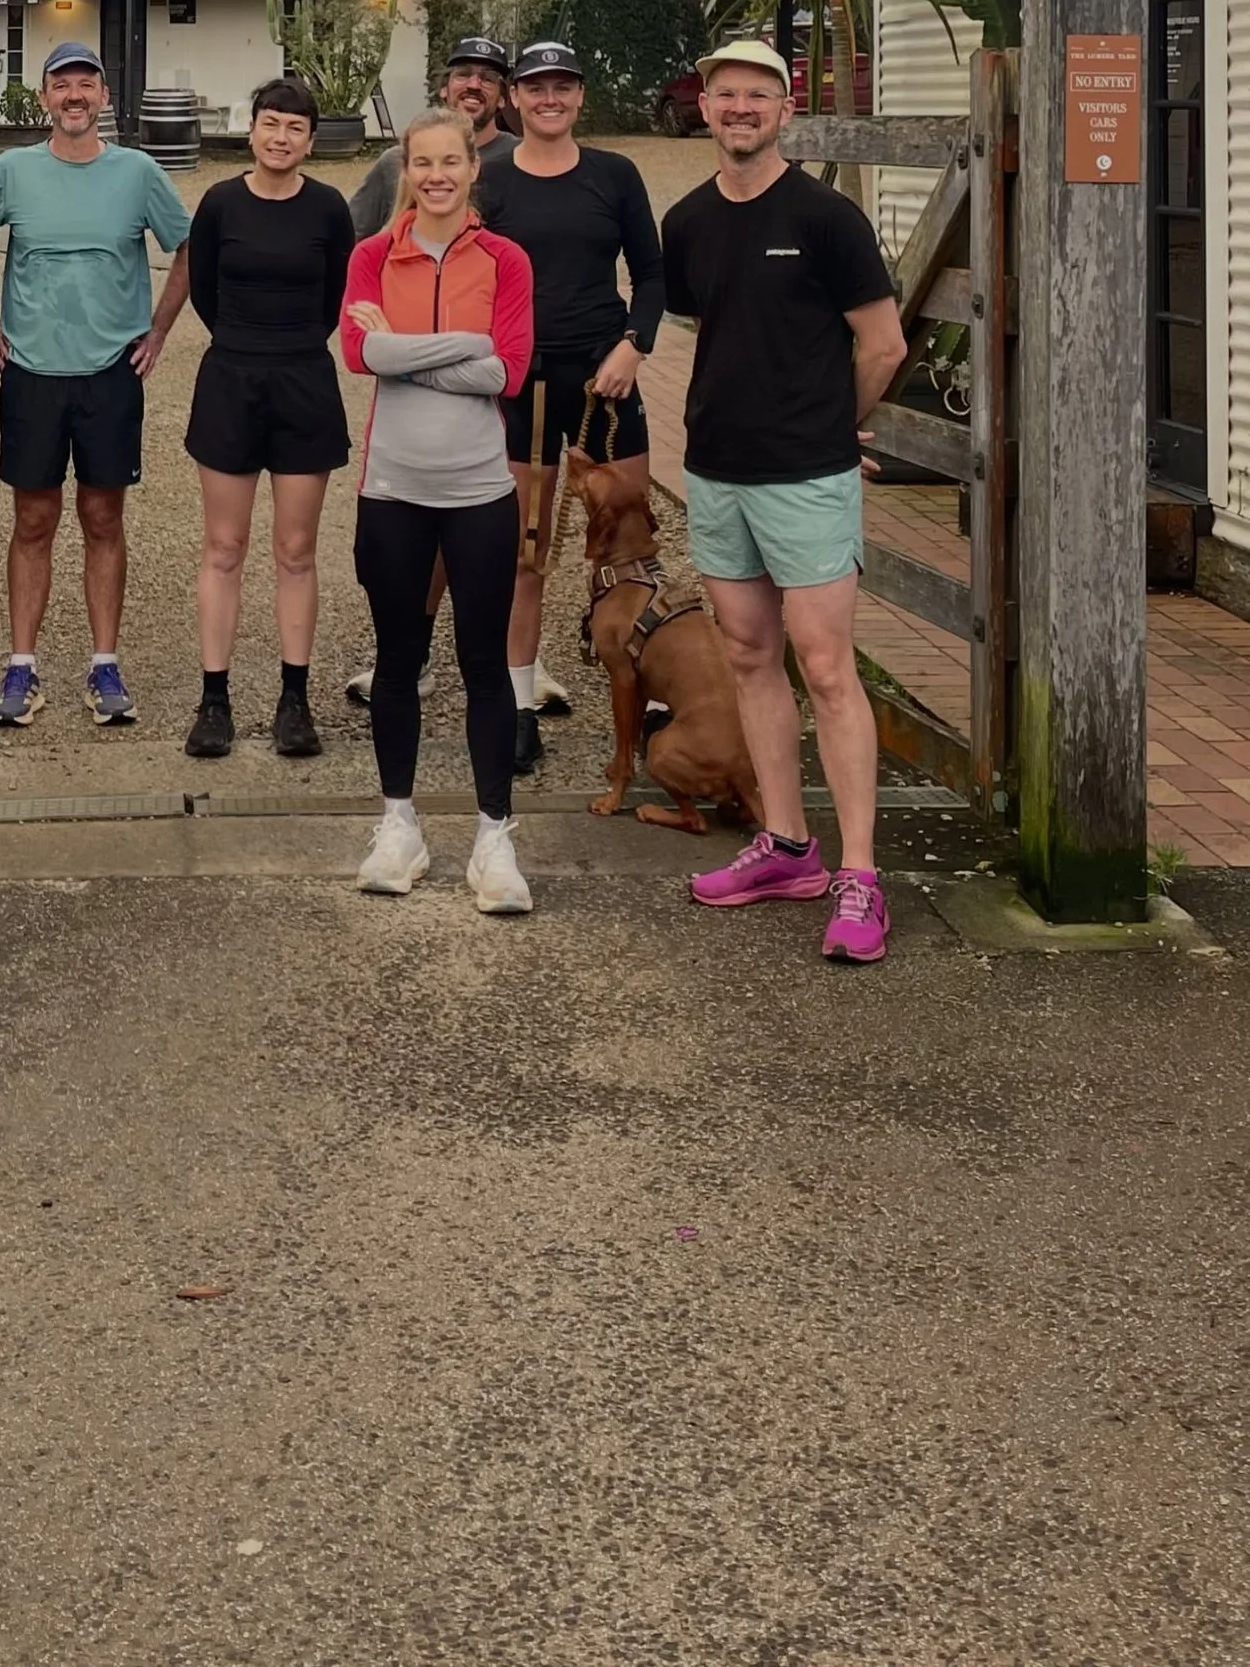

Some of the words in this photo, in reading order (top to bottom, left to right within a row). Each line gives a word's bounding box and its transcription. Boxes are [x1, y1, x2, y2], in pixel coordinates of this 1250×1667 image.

[1075, 75, 1092, 87] NO
[1094, 75, 1133, 88] ENTRY
[1078, 102, 1128, 114] VISITORS
[1089, 117, 1118, 128] CARS
[1089, 132, 1118, 143] ONLY
